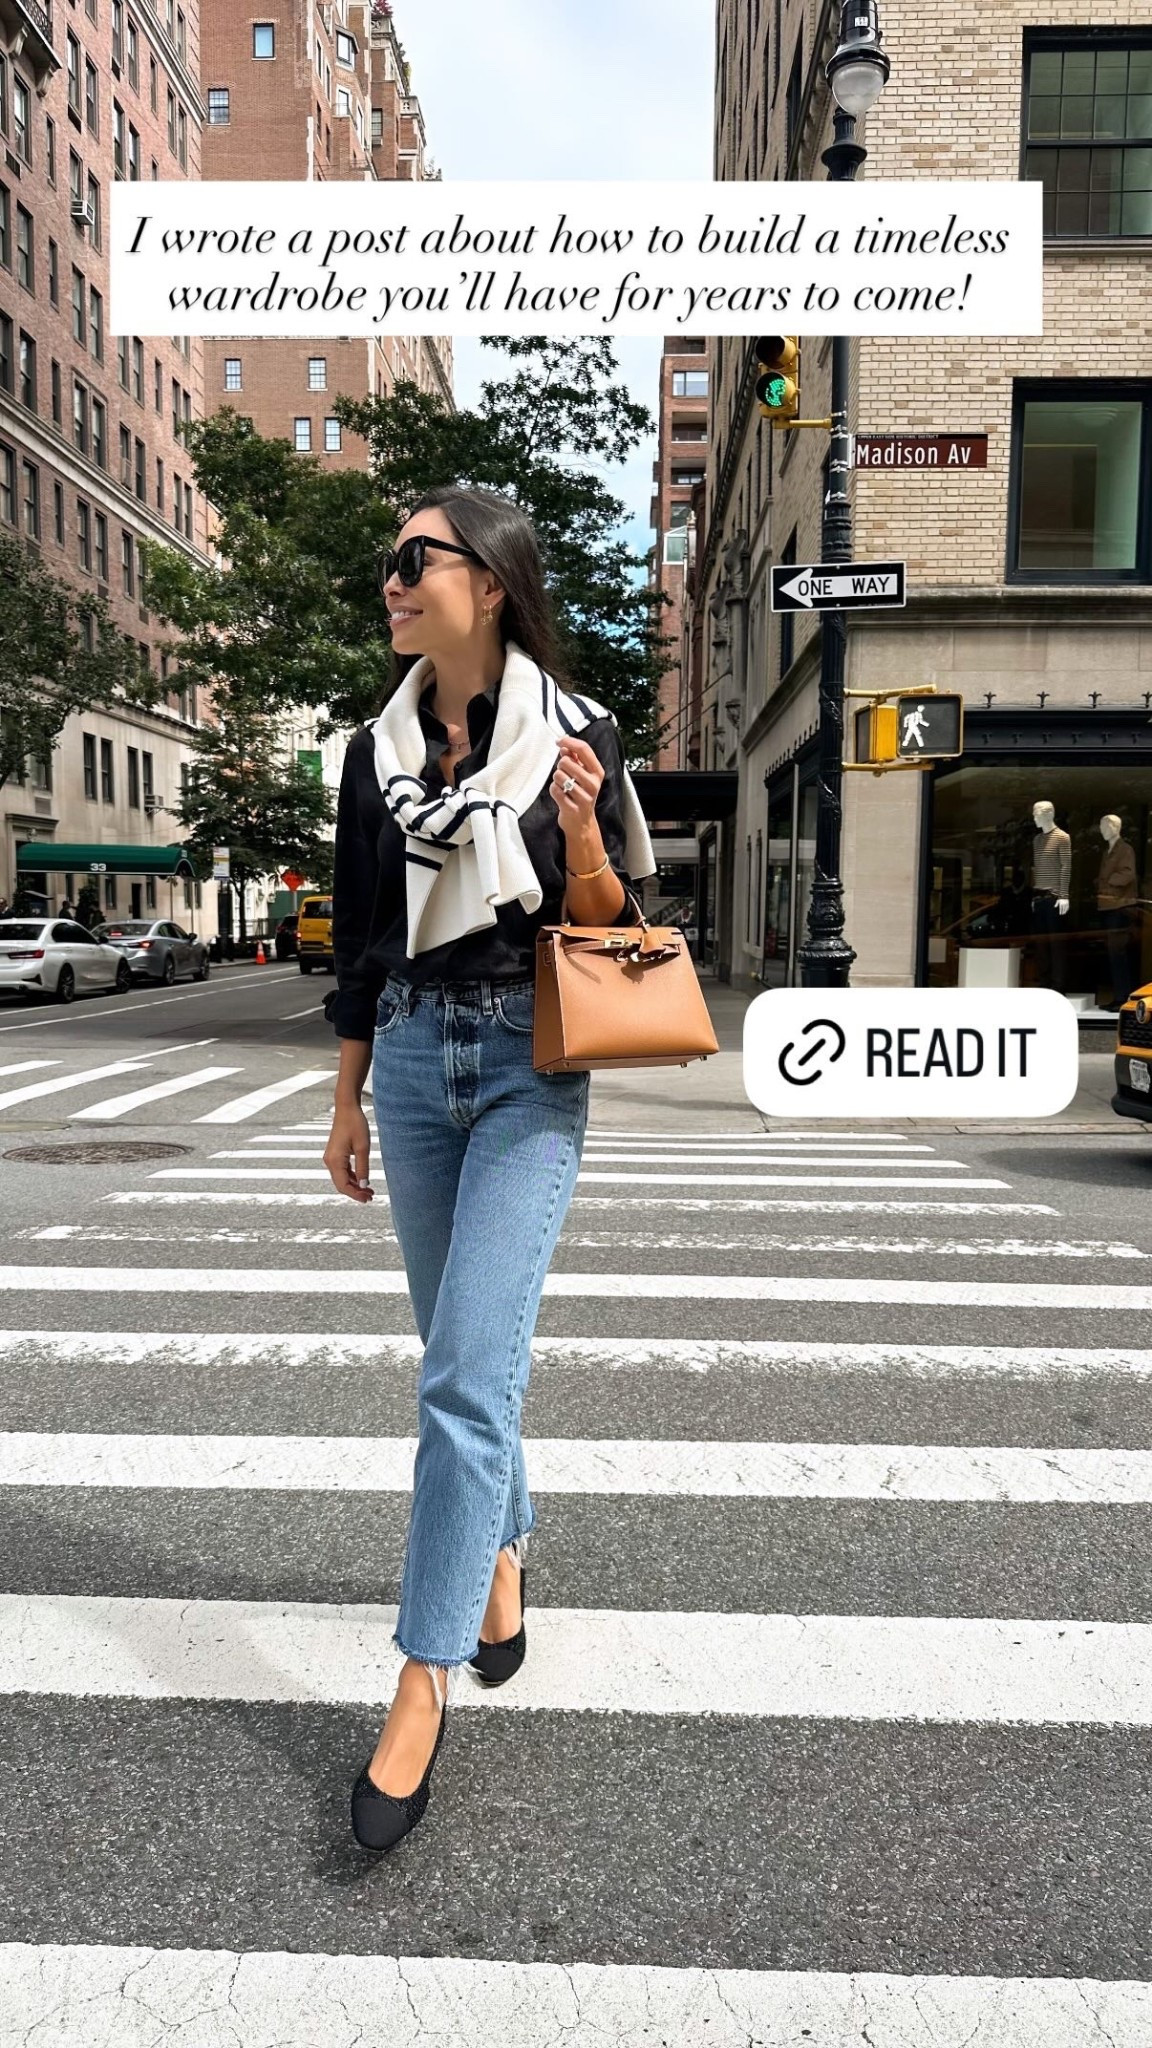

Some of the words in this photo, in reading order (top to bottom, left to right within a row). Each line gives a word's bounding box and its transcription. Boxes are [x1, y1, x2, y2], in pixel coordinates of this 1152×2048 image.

[857, 442, 938, 465] Madison
[947, 443, 971, 464] Av
[798, 579, 833, 597] ONE
[851, 576, 890, 594] WAY
[90, 862, 107, 872] 33
